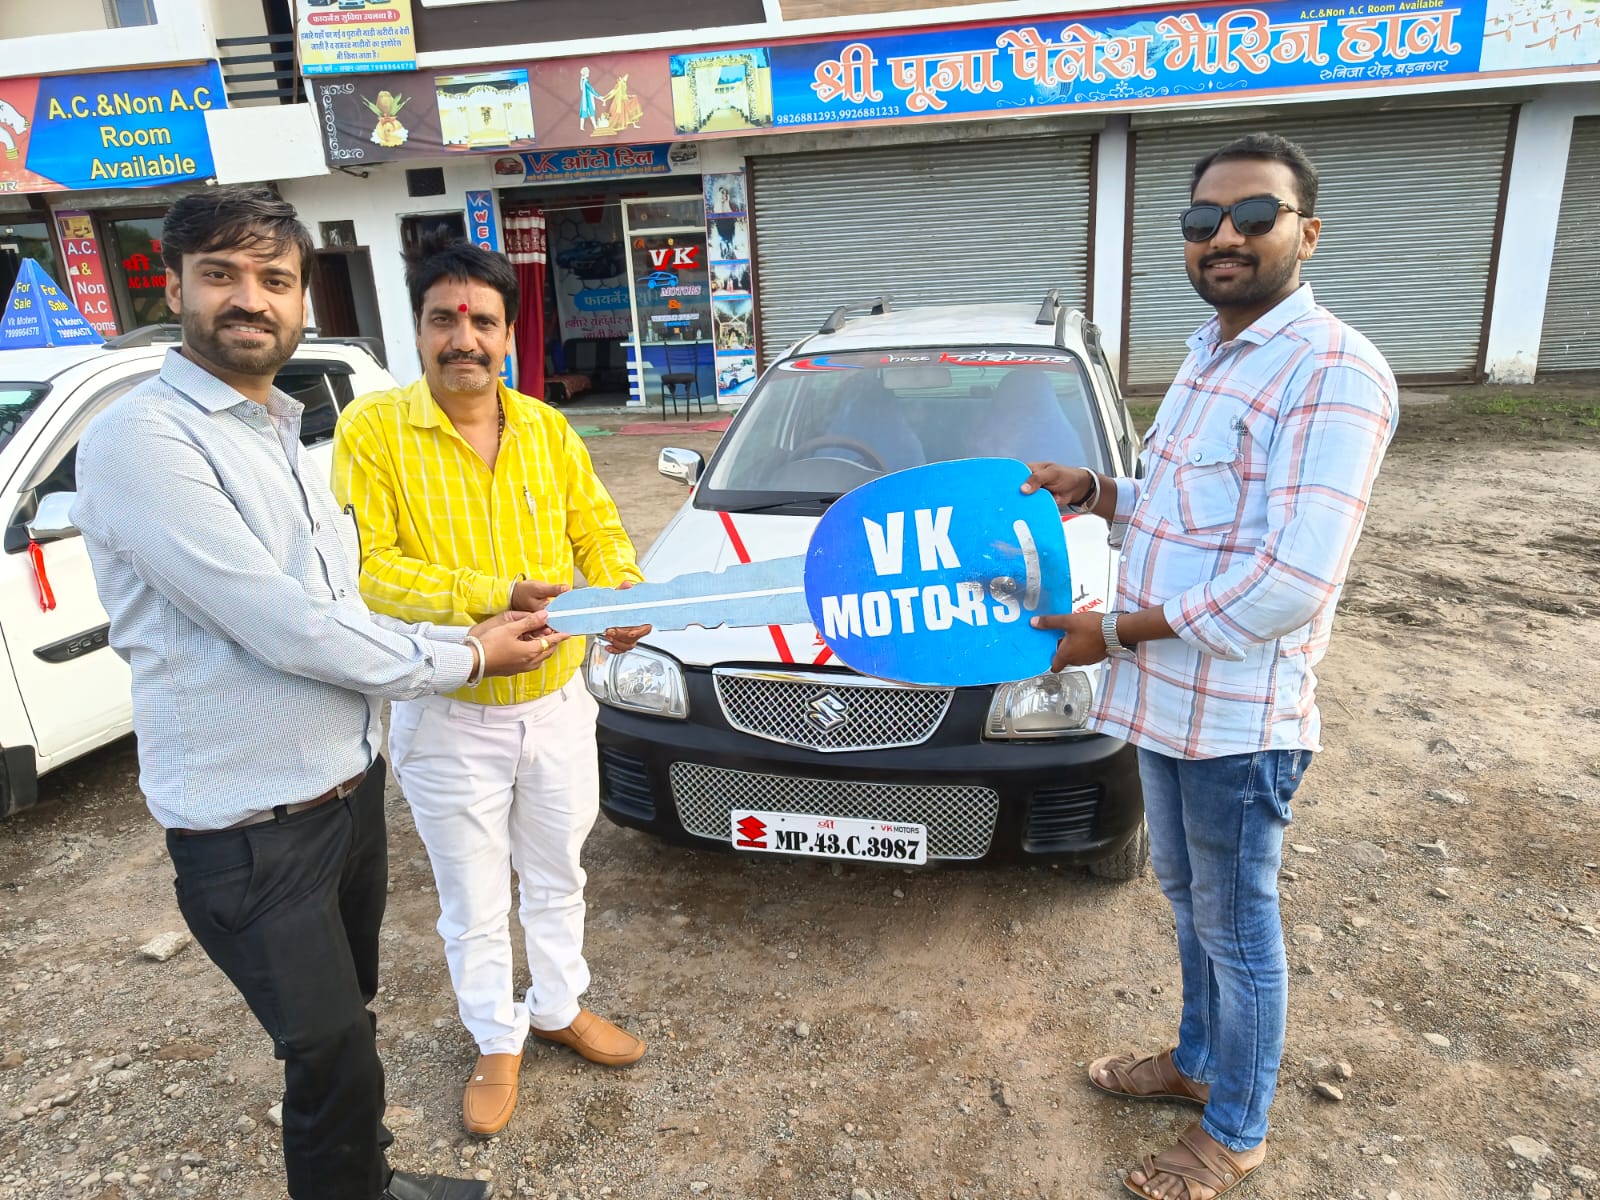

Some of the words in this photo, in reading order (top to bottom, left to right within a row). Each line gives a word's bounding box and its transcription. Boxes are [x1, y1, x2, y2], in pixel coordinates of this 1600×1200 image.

[1300, 8, 1345, 19] A.C.&Non
[1349, 5, 1364, 15] A.C
[1367, 3, 1395, 14] Room
[1399, 0, 1444, 11] Available
[811, 42, 883, 103] श्री
[887, 48, 1003, 112] पूजा
[996, 23, 1157, 86] पैलेस
[1156, 8, 1329, 76] मैरिज
[1337, 8, 1462, 65] हाल
[48, 90, 166, 121] A.C.&Non
[169, 86, 212, 112] A.C
[100, 125, 172, 148] Room
[90, 153, 196, 180] Available
[528, 153, 558, 173] VK
[562, 149, 610, 171] ऑटो
[614, 147, 654, 167] डिल
[67, 241, 97, 255] A.C.
[649, 245, 699, 271] VK
[81, 262, 92, 276] &
[16, 282, 31, 293] For
[40, 284, 57, 296] For
[76, 281, 106, 295] Non
[14, 298, 32, 310] Sale
[48, 299, 69, 311] Sale
[84, 301, 108, 314] A.C
[91, 320, 117, 331] ooms
[863, 506, 961, 576] VK
[821, 582, 1021, 640] MOTORS
[817, 820, 835, 830] श्री
[893, 826, 920, 834] MOTORS
[775, 830, 920, 860] MP.43.C.3987
